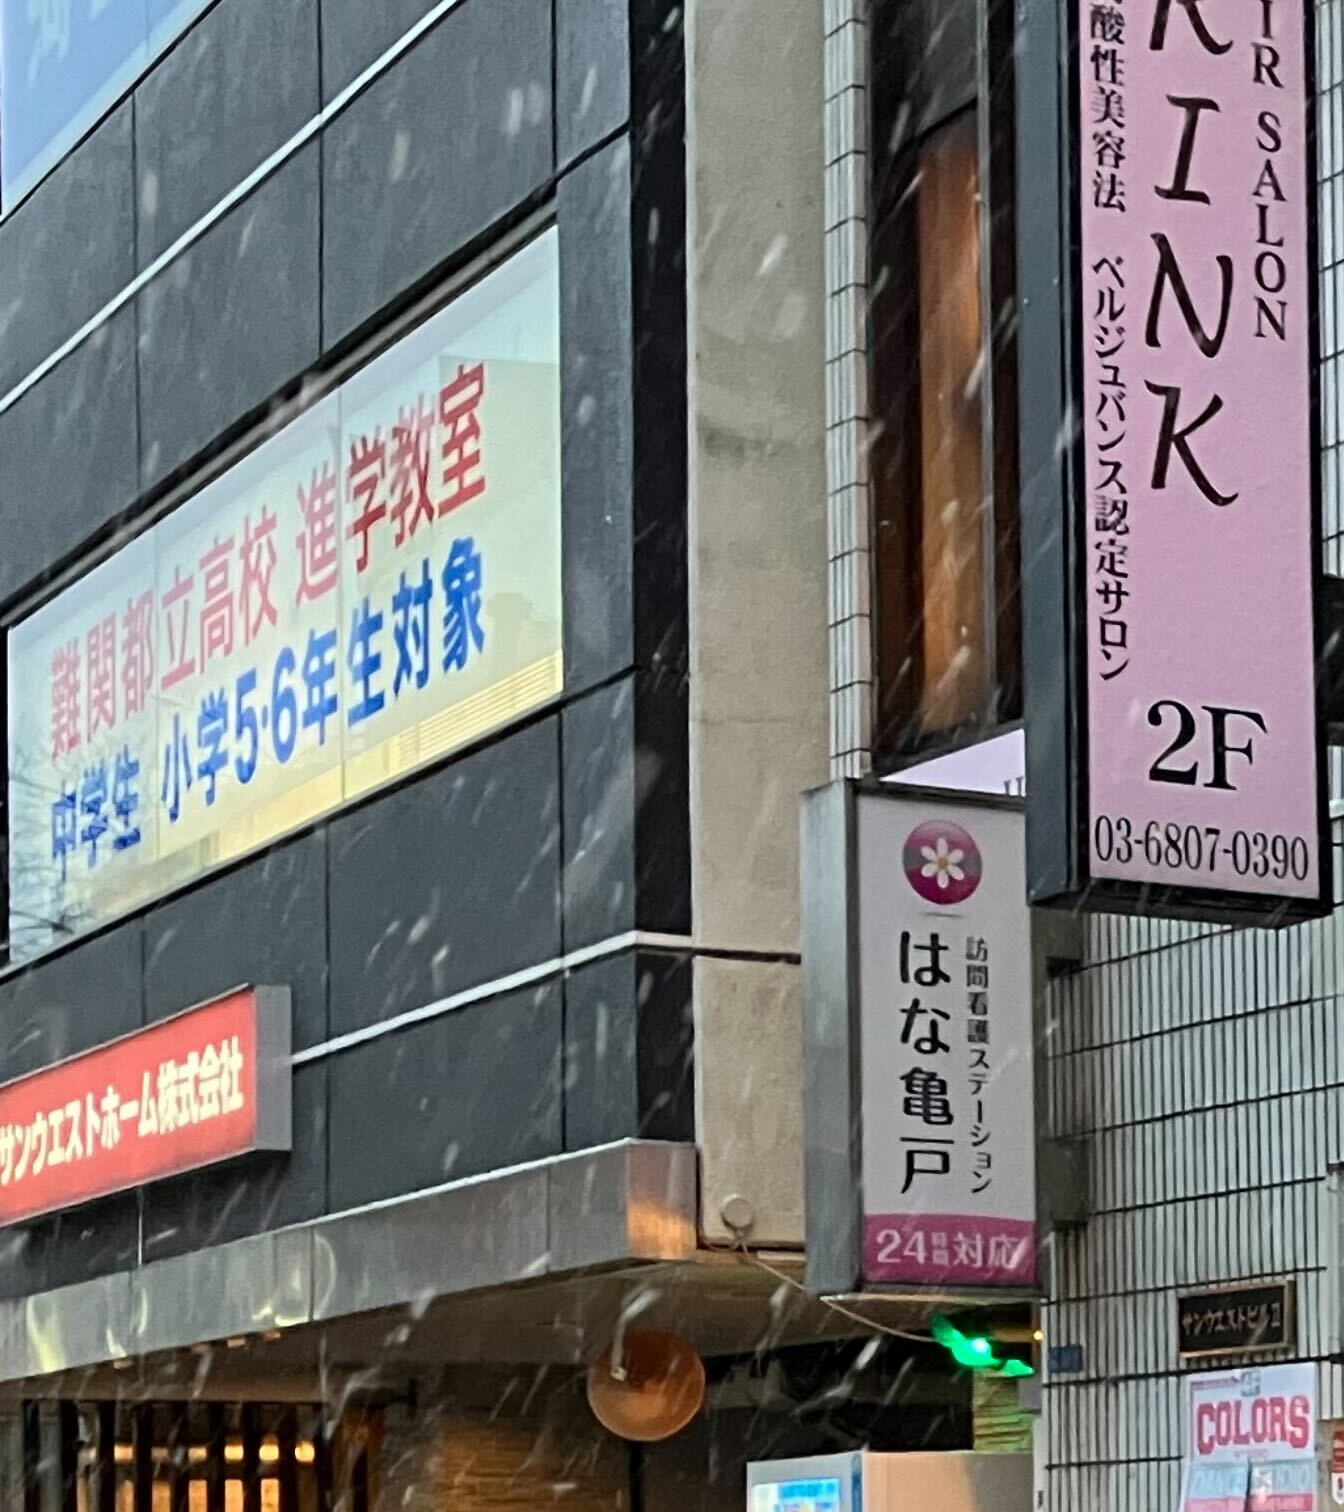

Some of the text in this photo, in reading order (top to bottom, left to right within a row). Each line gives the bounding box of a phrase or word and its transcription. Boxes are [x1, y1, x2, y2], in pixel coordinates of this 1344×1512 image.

[1252, 110, 1287, 341] SALON
[1089, 0, 1130, 681] 酸性美容法 ベルジュバンス認定サロン
[50, 362, 487, 761] 難関都立高校 進学教室
[51, 743, 141, 882] 中学生
[1147, 699, 1268, 791] 2F
[1095, 815, 1309, 881] 03-6807-0390
[899, 930, 955, 1195] はな亀戸
[1197, 1394, 1310, 1456] COLORS
